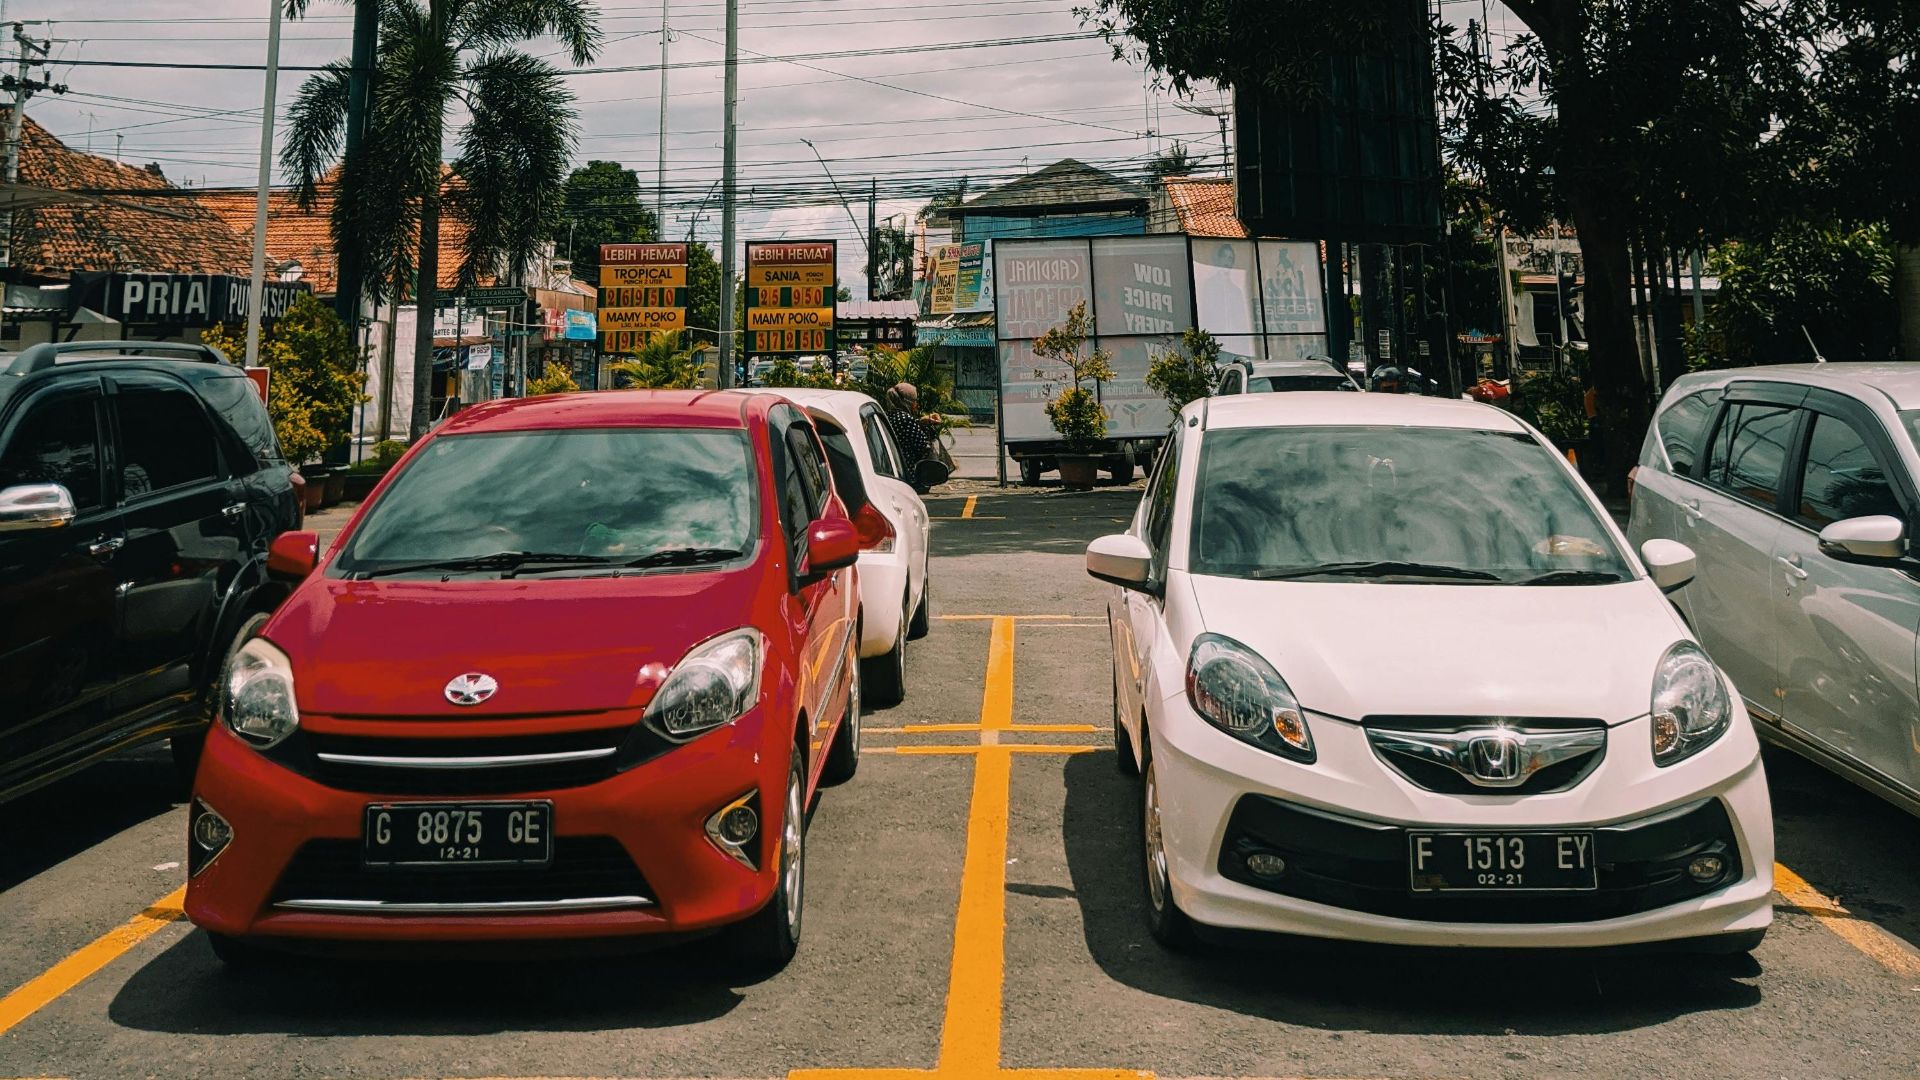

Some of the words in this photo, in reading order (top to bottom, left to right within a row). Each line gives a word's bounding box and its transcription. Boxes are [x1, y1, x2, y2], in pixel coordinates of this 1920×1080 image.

[604, 249, 637, 261] LEBIH
[641, 248, 682, 260] HEMAT
[752, 249, 784, 261] LEBIH
[788, 247, 828, 260] HEMAT
[614, 268, 673, 279] TROPICAL
[765, 271, 801, 282] SANIA
[122, 281, 206, 315] PRIA
[229, 283, 269, 318] PUNA
[606, 312, 641, 323] MAMY
[644, 312, 677, 322] POKO
[752, 312, 786, 325] MAMY
[788, 312, 819, 324] POKO
[433, 328, 450, 336] ARTEG
[376, 812, 391, 844] G
[417, 811, 482, 844] 8875
[508, 811, 540, 844] GE
[1417, 837, 1433, 870] F
[1464, 837, 1525, 870] 1513
[1557, 836, 1588, 869] EY
